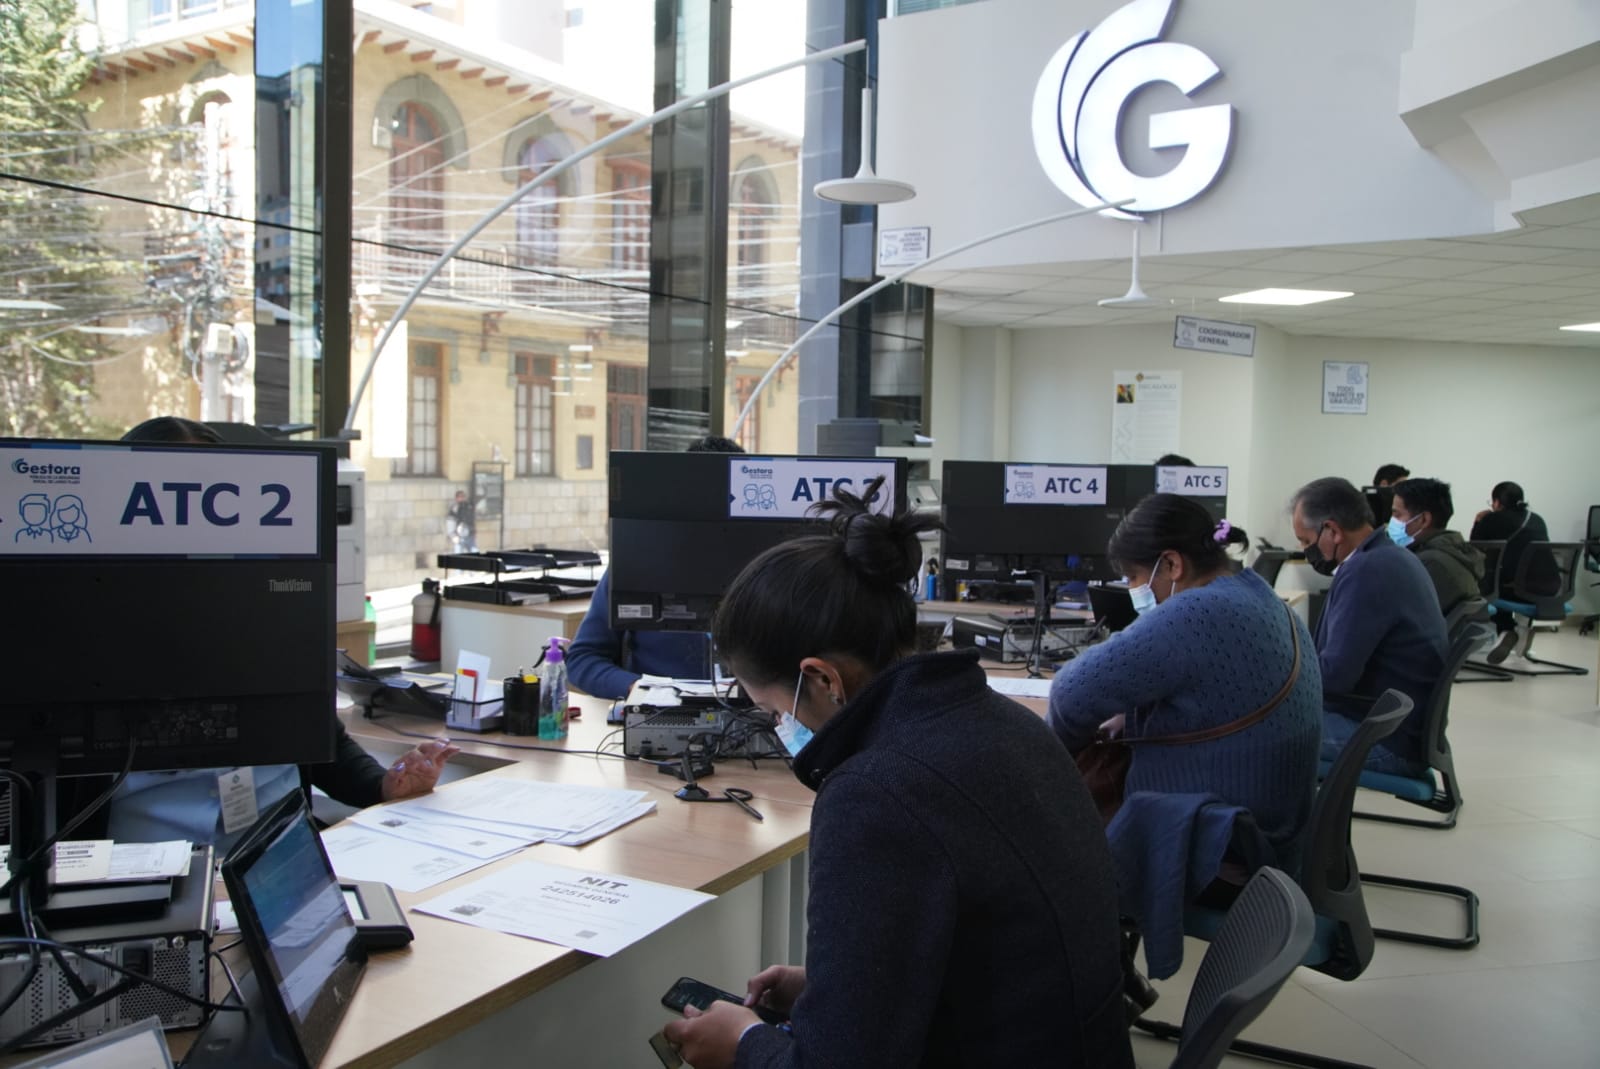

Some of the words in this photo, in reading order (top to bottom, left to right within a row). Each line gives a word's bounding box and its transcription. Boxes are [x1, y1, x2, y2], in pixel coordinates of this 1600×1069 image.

[1072, 41, 1236, 213] G
[1198, 327, 1251, 339] COORDINADOR
[1198, 335, 1230, 346] GENERAL
[15, 460, 81, 475] Gestora
[741, 466, 773, 475] Gestora
[1044, 477, 1082, 494] ATC
[1086, 478, 1099, 494] 4
[1184, 475, 1211, 488] ATC
[1213, 475, 1222, 488] 5
[791, 477, 853, 502] ATC
[120, 482, 241, 526] ATC
[259, 483, 293, 527] 2
[268, 578, 313, 592] ThinkVision
[579, 876, 628, 889] NIT
